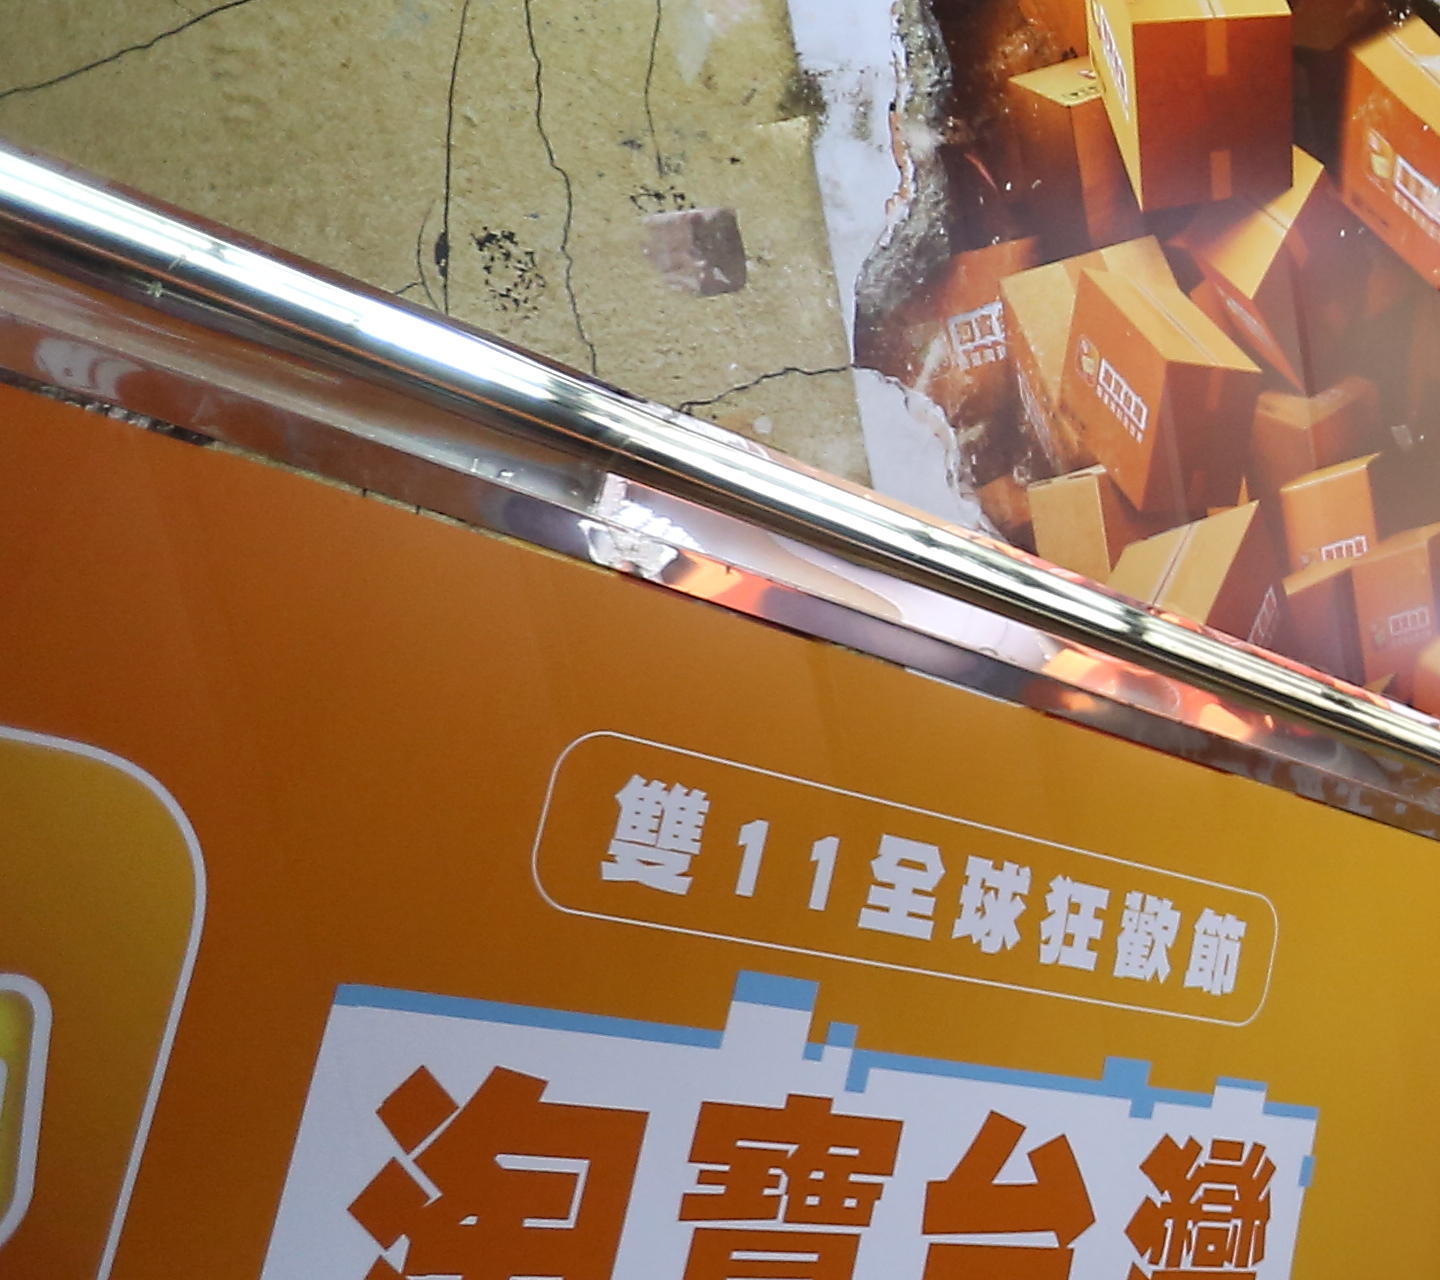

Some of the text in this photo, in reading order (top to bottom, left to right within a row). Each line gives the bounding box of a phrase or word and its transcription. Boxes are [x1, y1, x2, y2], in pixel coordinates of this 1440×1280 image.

[601, 774, 1247, 998] 雙11全球狂歡節
